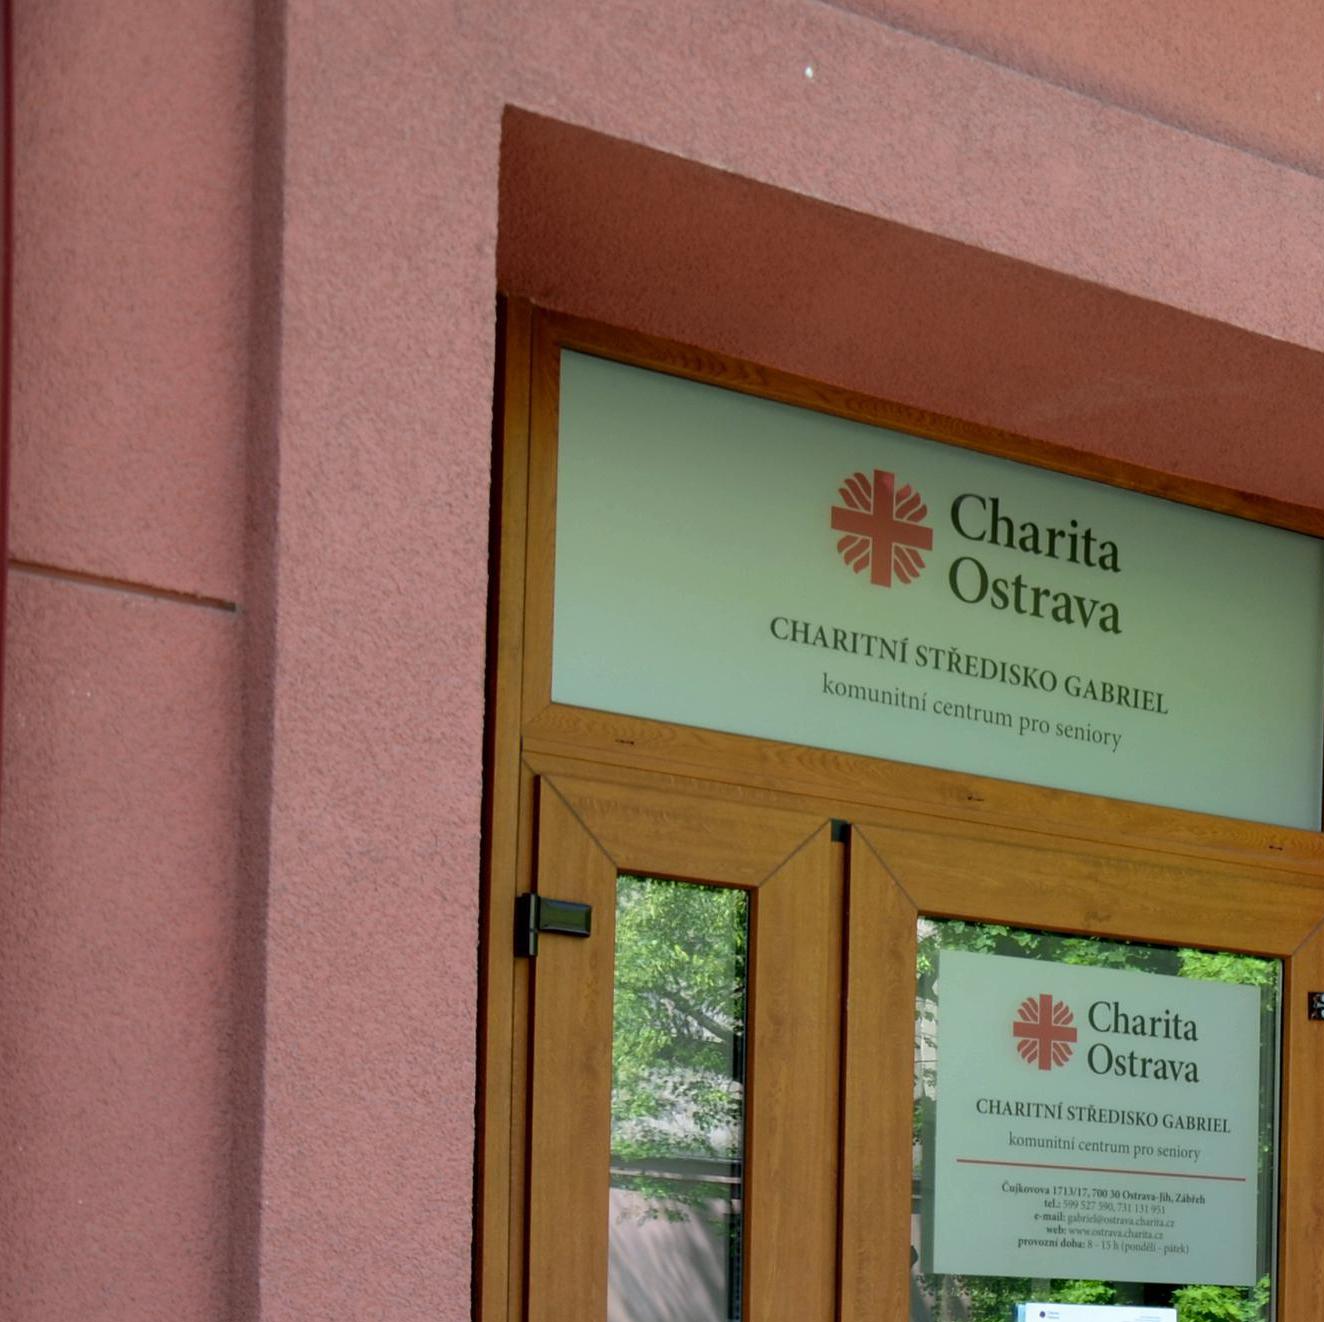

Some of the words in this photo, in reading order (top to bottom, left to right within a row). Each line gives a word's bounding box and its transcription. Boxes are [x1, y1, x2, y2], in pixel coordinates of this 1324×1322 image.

[951, 493, 1121, 573] Charita
[948, 556, 1122, 634] Ostrava
[770, 616, 908, 664] CHARITNÍ
[916, 643, 1057, 693] STŘEDISKO
[1064, 675, 1169, 715] GABRIEL
[823, 673, 927, 712] komunitní
[933, 696, 1013, 728] centrum
[1019, 714, 1050, 736] pro
[1056, 722, 1122, 752] seniory
[1088, 1000, 1199, 1042] Charita
[1087, 1043, 1199, 1084] Ostrava
[976, 1098, 1063, 1120] CHARITNÍ
[1067, 1104, 1158, 1128] STŘEDISKO
[1163, 1113, 1231, 1133] GABRIEL
[1008, 1131, 1075, 1151] komunitní
[1078, 1140, 1129, 1155] centrum
[1133, 1145, 1153, 1159] pro
[1157, 1146, 1201, 1164] seniory
[1092, 1187, 1108, 1198] 700
[1110, 1188, 1120, 1199] 30
[1034, 1211, 1065, 1221] e-mail:
[1046, 1224, 1066, 1234] web:
[1018, 1237, 1058, 1249] provozní
[1060, 1237, 1086, 1248] doba:
[1087, 1239, 1093, 1249] 8
[1102, 1239, 1111, 1250] 15
[1113, 1240, 1119, 1250] h
